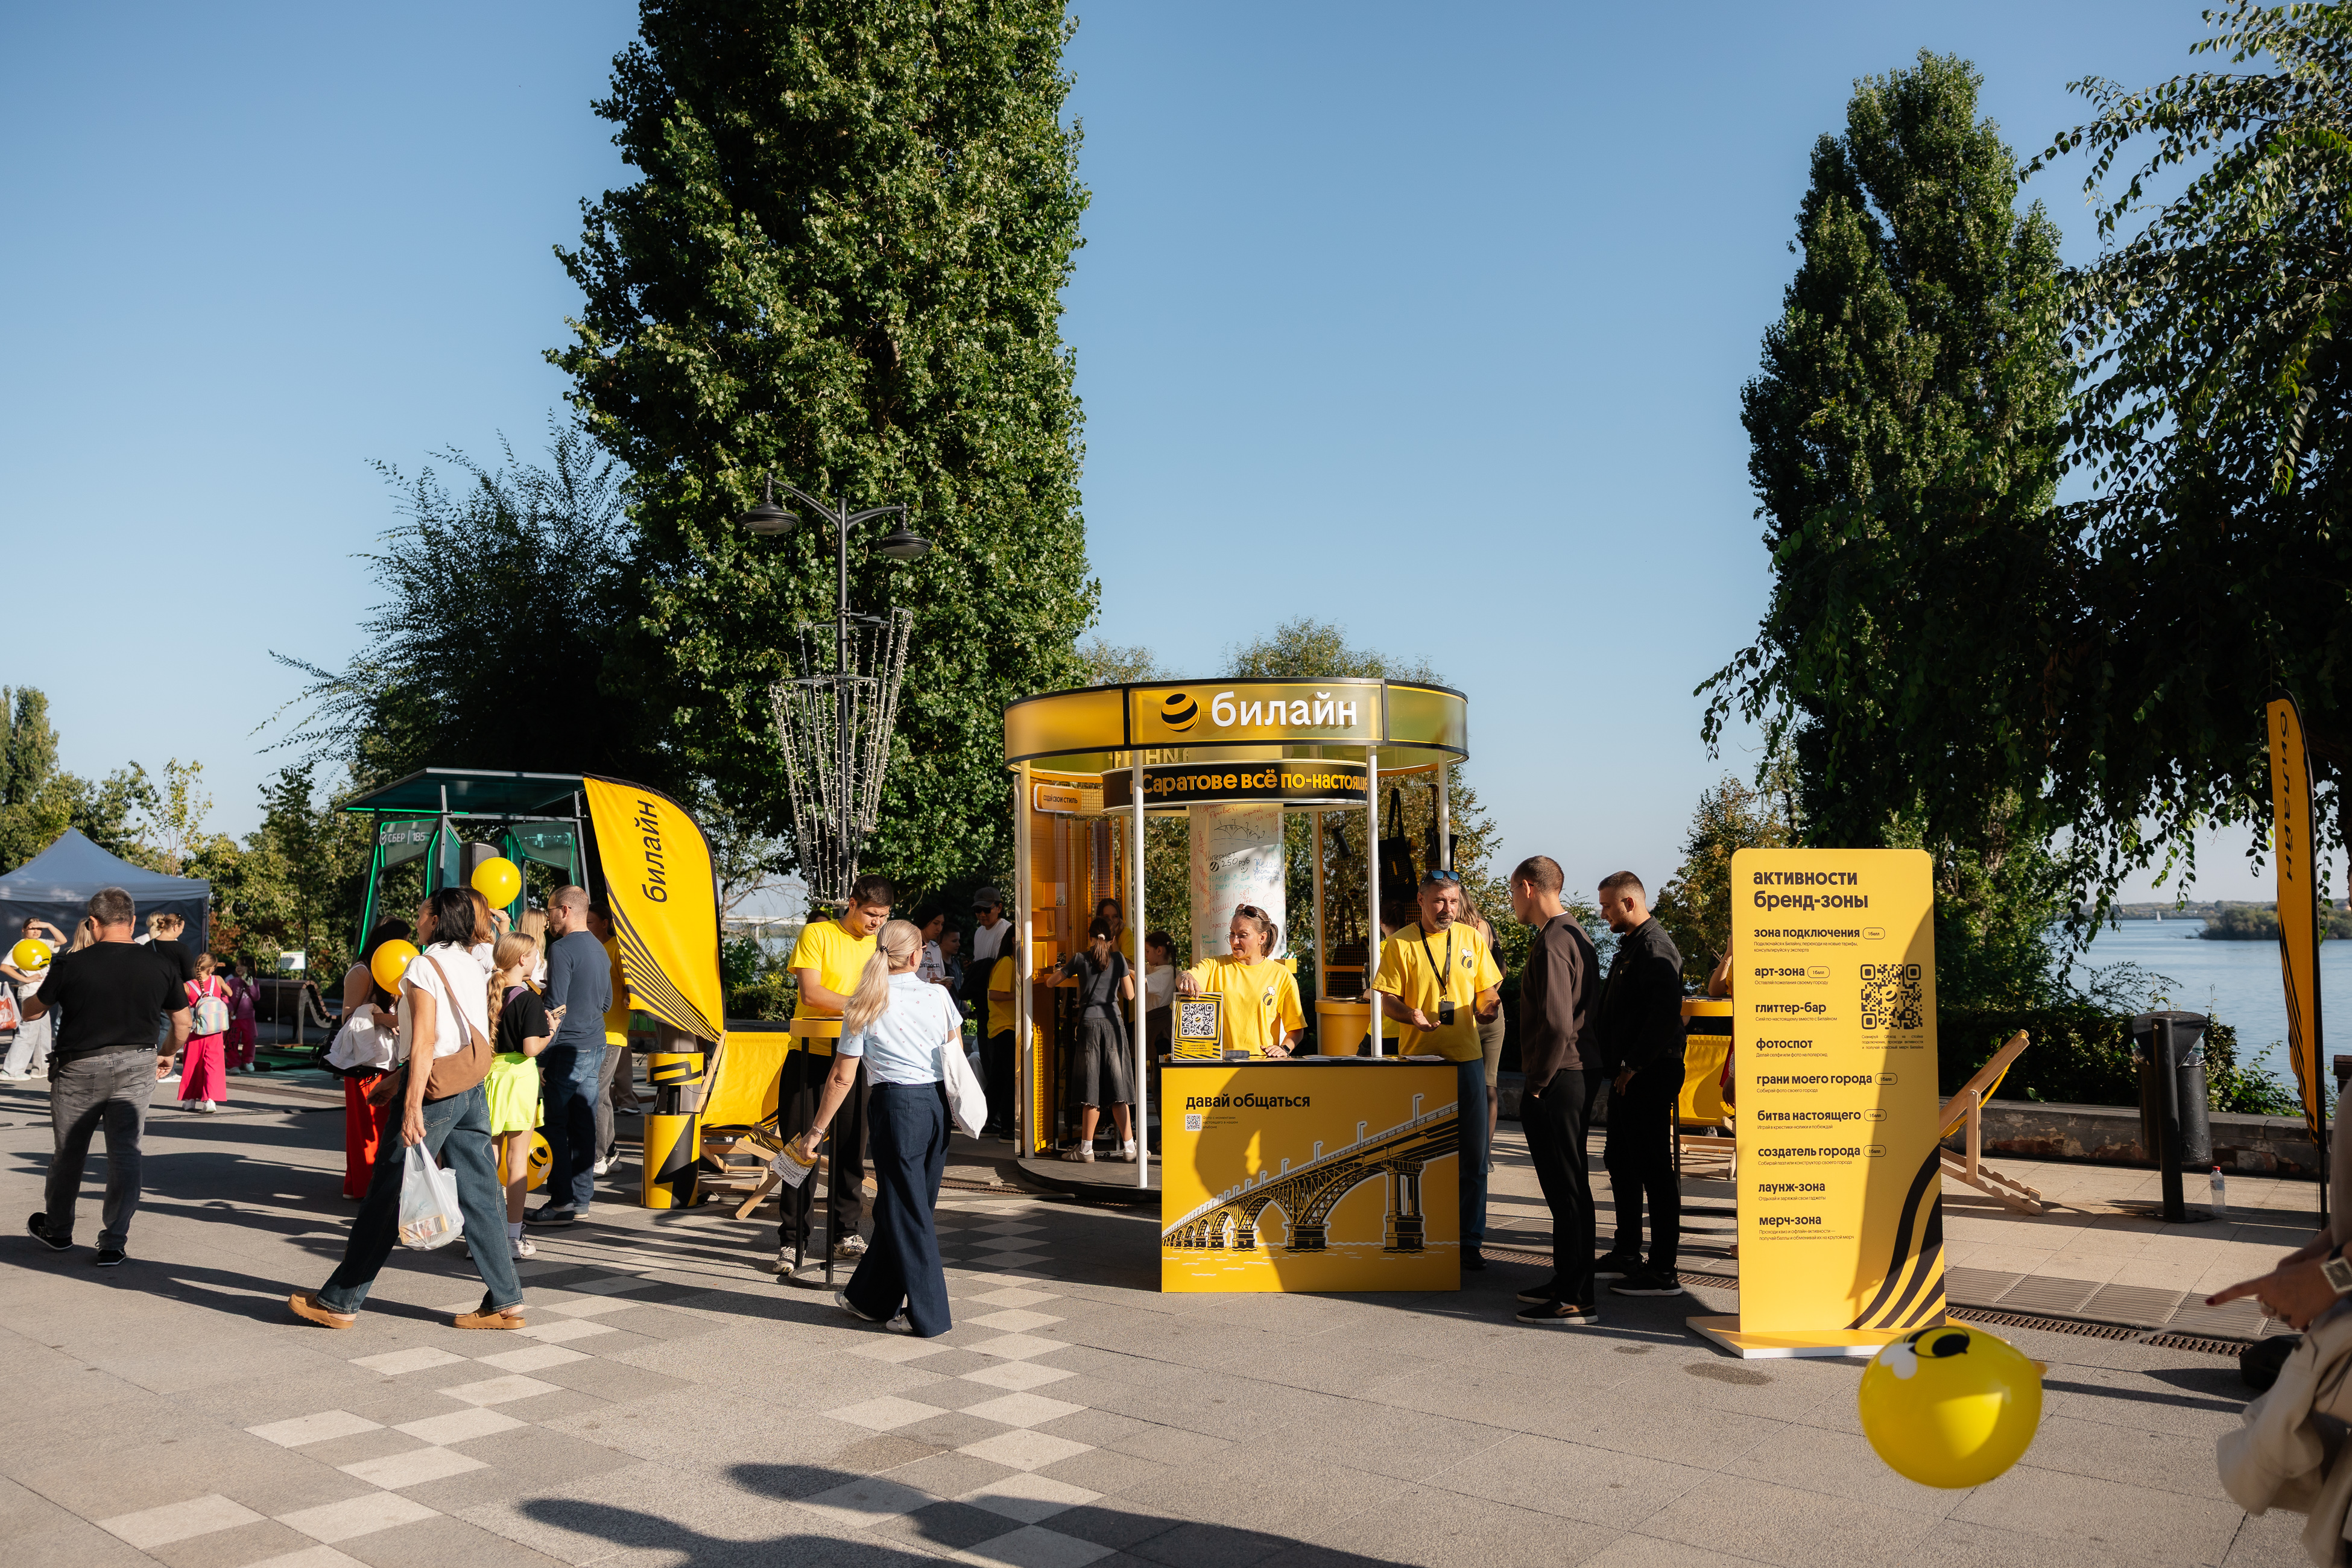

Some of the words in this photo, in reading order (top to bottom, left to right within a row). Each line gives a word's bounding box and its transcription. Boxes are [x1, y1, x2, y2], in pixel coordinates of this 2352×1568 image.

[1212, 691, 1357, 727] билайн
[1143, 774, 1238, 796] Саратове
[1241, 769, 1278, 789] всё
[1281, 774, 1367, 794] по-настояще
[2280, 711, 2293, 882] билайн
[388, 833, 405, 842] СБЕР
[412, 832, 425, 842] 185
[634, 800, 667, 903] билайн
[1221, 858, 1238, 867] 250
[1238, 857, 1250, 867] руб
[1753, 872, 1857, 885] активности
[1754, 890, 1868, 911] бренд-зоны
[1783, 929, 1860, 939] подключения
[1755, 968, 1805, 978] арт-зона
[1756, 1002, 1826, 1015] глиттер-бар
[1756, 1038, 1813, 1051] фотоспот
[1757, 1076, 1789, 1087] грани
[1792, 1075, 1829, 1084] моего
[1831, 1075, 1872, 1086] города
[1186, 1093, 1230, 1110] давай
[1233, 1093, 1310, 1110] общаться
[1757, 1110, 1790, 1121] битва
[1792, 1111, 1861, 1122] настоящего
[1758, 1148, 1816, 1159] создатель
[1819, 1148, 1860, 1159] города
[1759, 1183, 1825, 1194] лаунж-зона
[1759, 1216, 1821, 1228] мерч-зона
